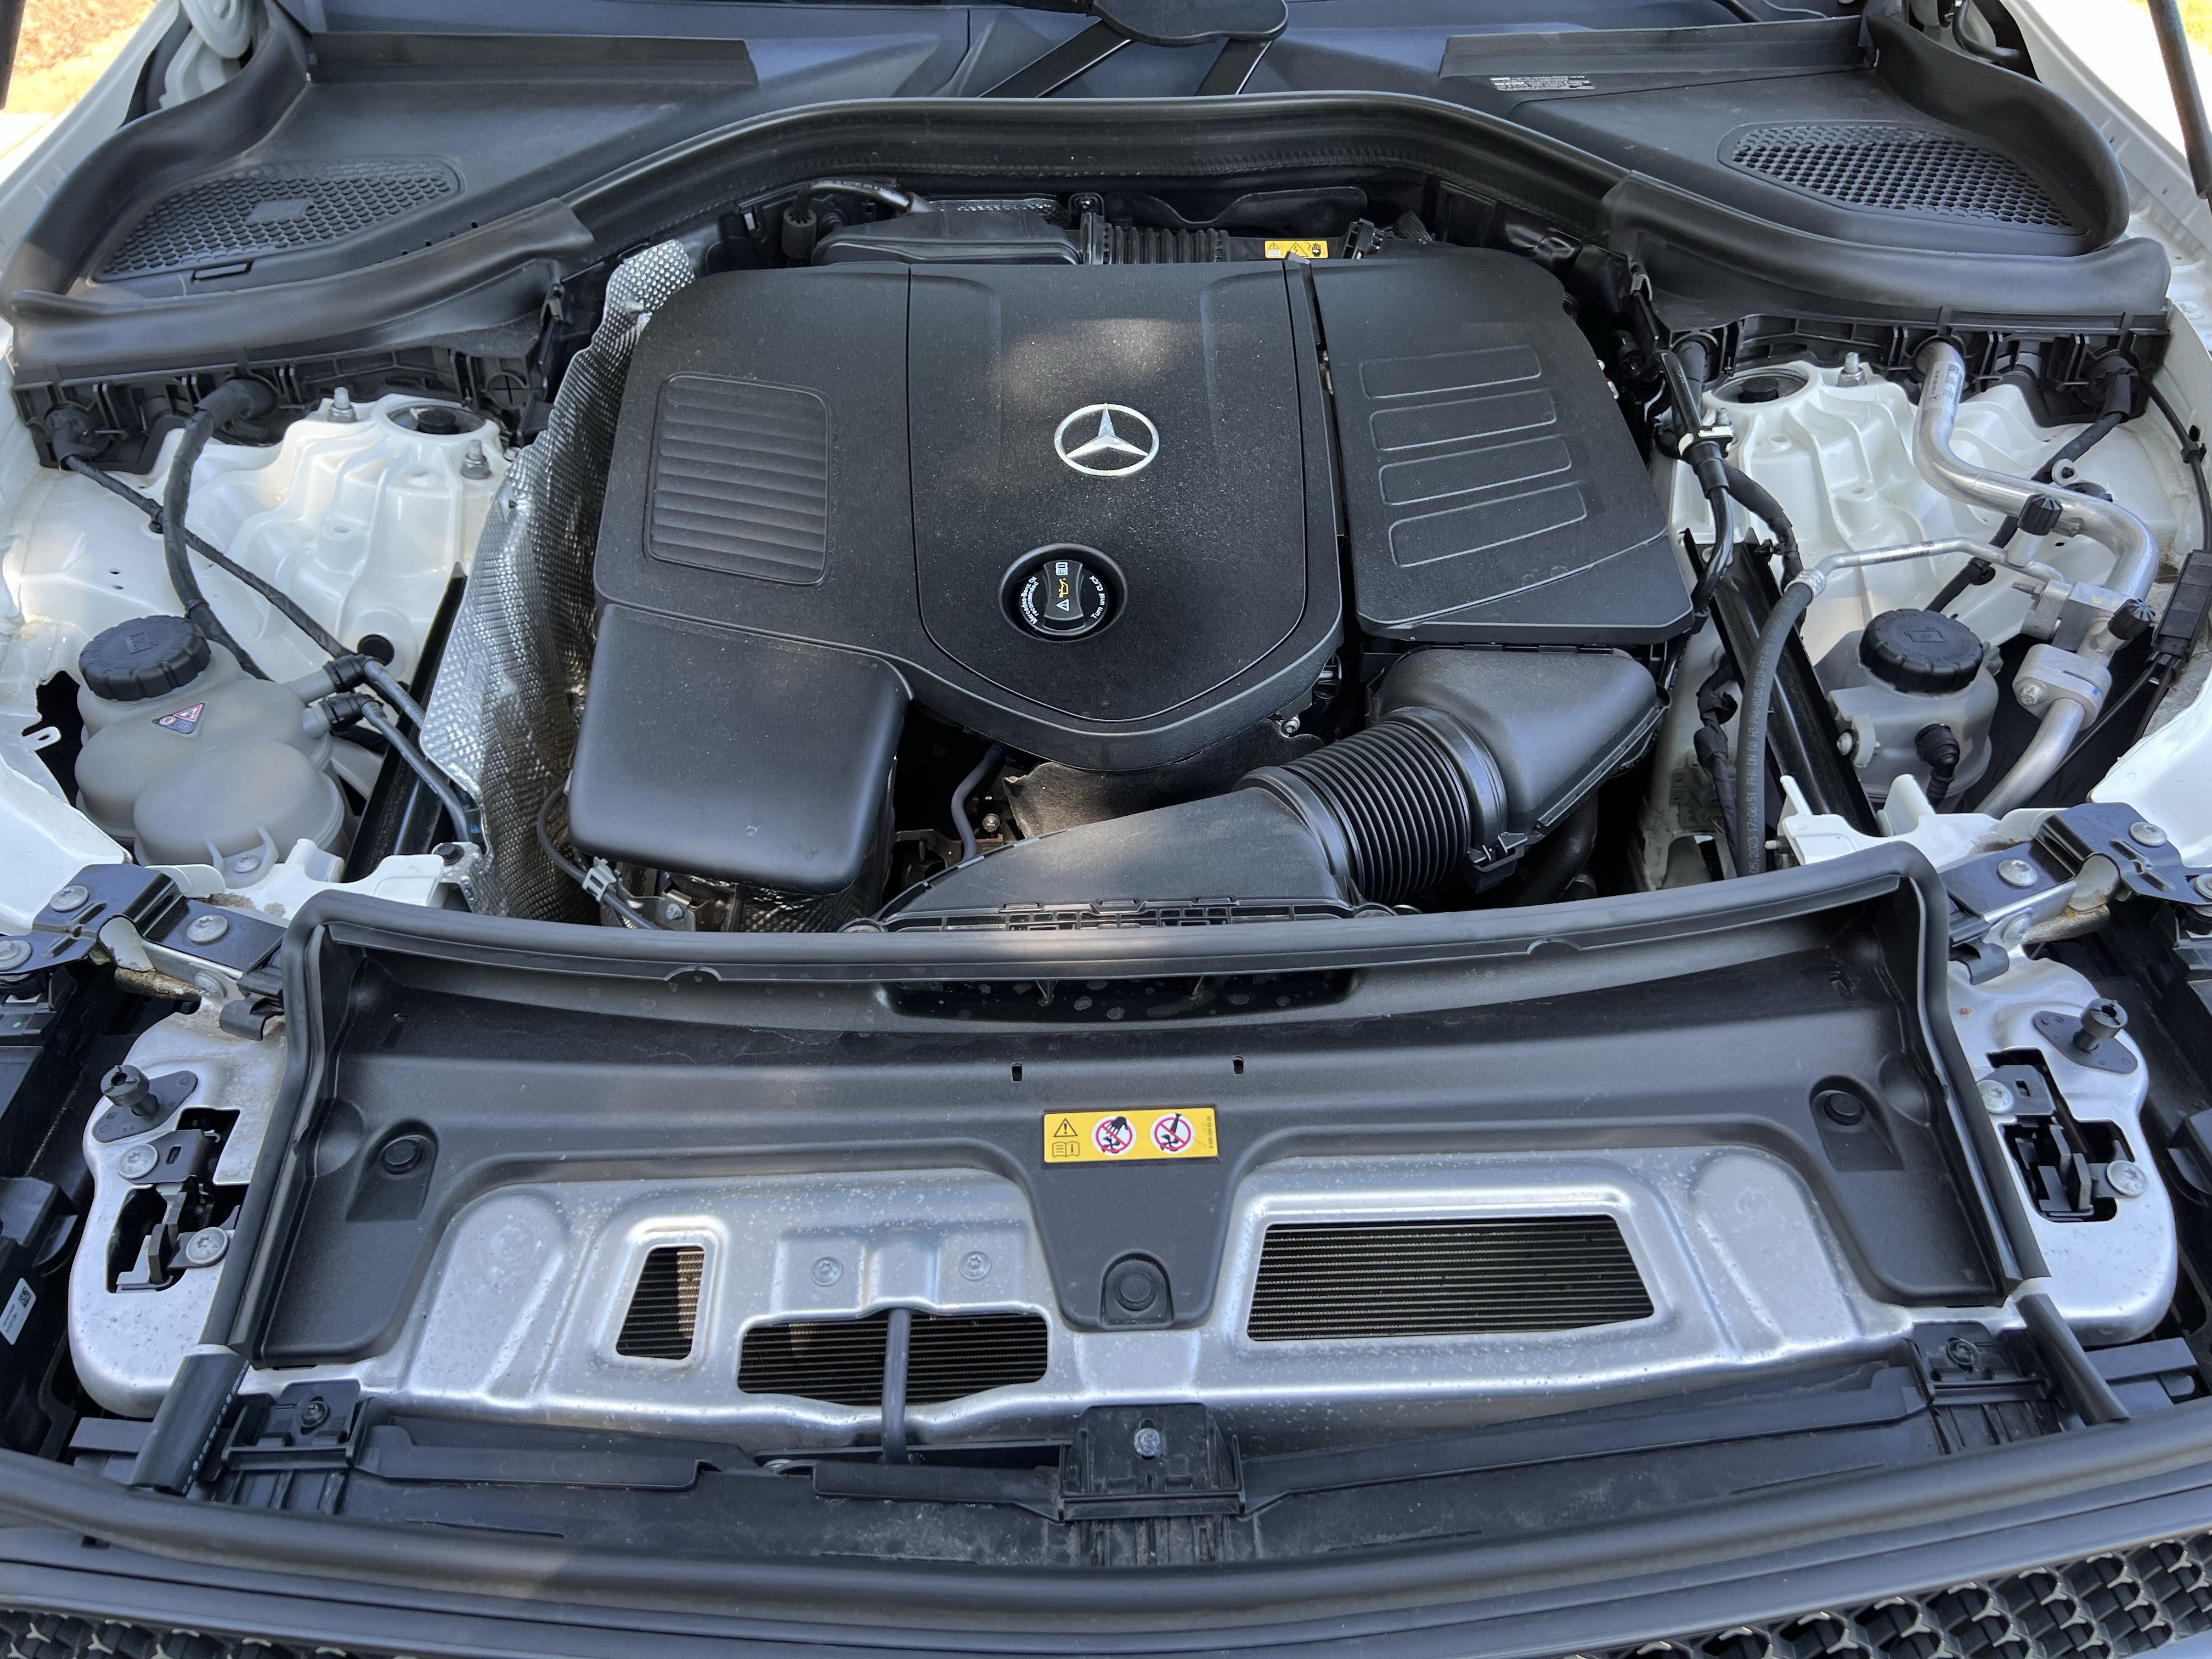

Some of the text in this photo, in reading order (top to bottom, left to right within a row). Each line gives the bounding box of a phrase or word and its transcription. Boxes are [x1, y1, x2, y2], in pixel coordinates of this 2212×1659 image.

[1089, 575, 1104, 591] CLICK
[1020, 583, 1038, 624] Mercedes-Benz
[1027, 581, 1039, 617] recommended
[1091, 607, 1103, 619] Turn
